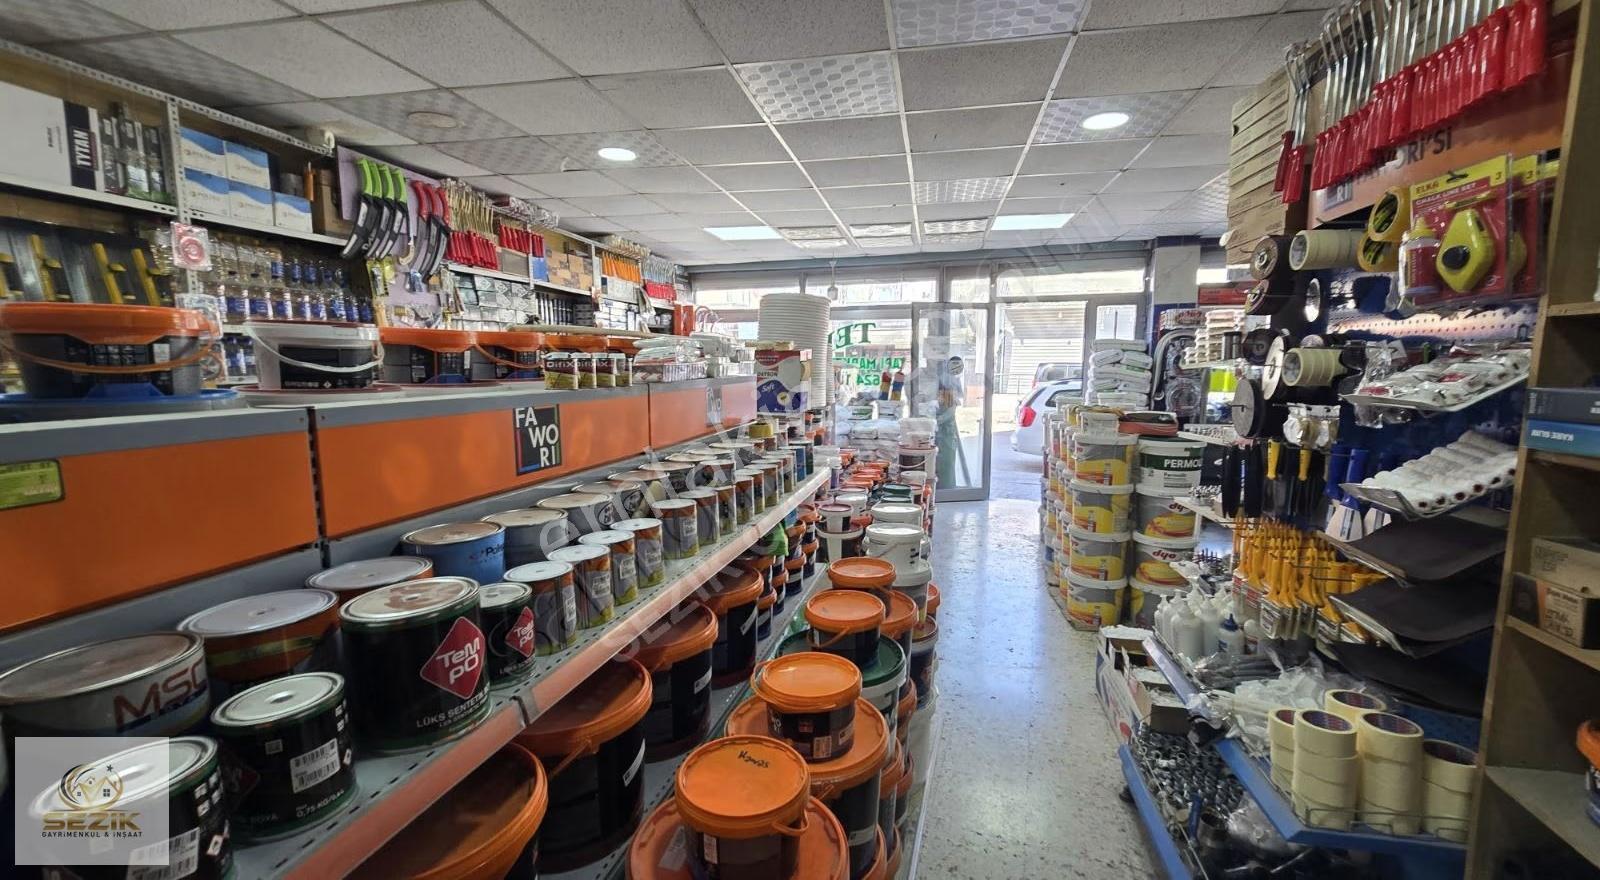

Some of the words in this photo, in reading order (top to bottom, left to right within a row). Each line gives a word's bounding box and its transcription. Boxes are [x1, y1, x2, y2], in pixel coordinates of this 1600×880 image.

[73, 129, 93, 166] TYTAN
[1415, 181, 1440, 195] ELKA
[515, 406, 538, 428] FA
[529, 424, 560, 447] WO
[540, 447, 557, 468] RI
[1152, 549, 1177, 560] dyo
